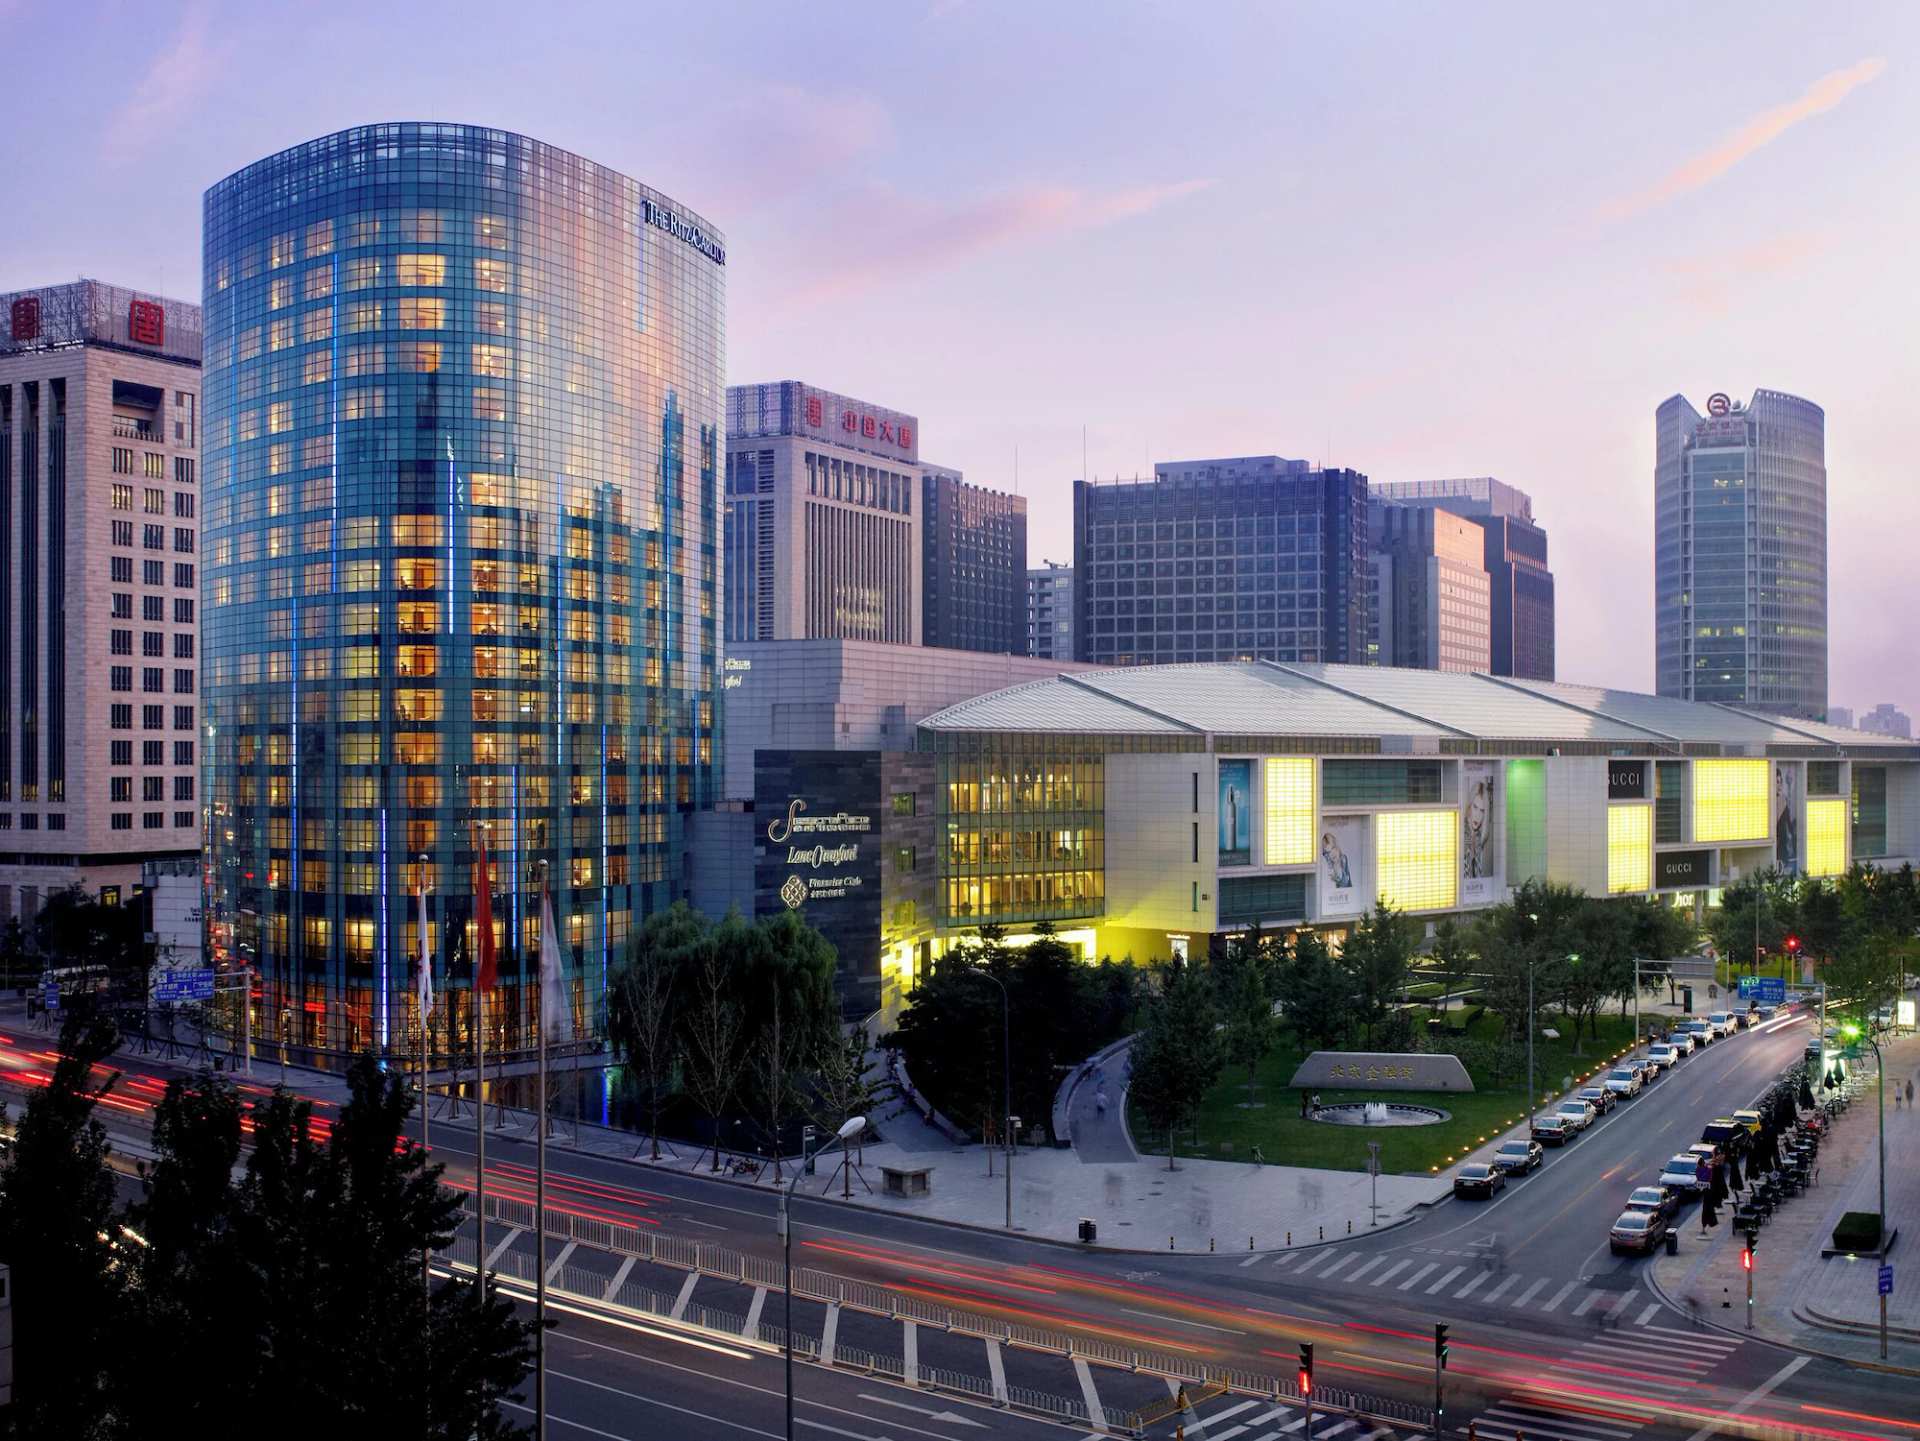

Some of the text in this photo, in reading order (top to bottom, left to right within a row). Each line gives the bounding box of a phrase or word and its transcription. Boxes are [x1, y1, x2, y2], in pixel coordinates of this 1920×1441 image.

[643, 200, 670, 231] THE
[1608, 773, 1640, 786] UCCI
[1666, 863, 1692, 873] GUCCI
